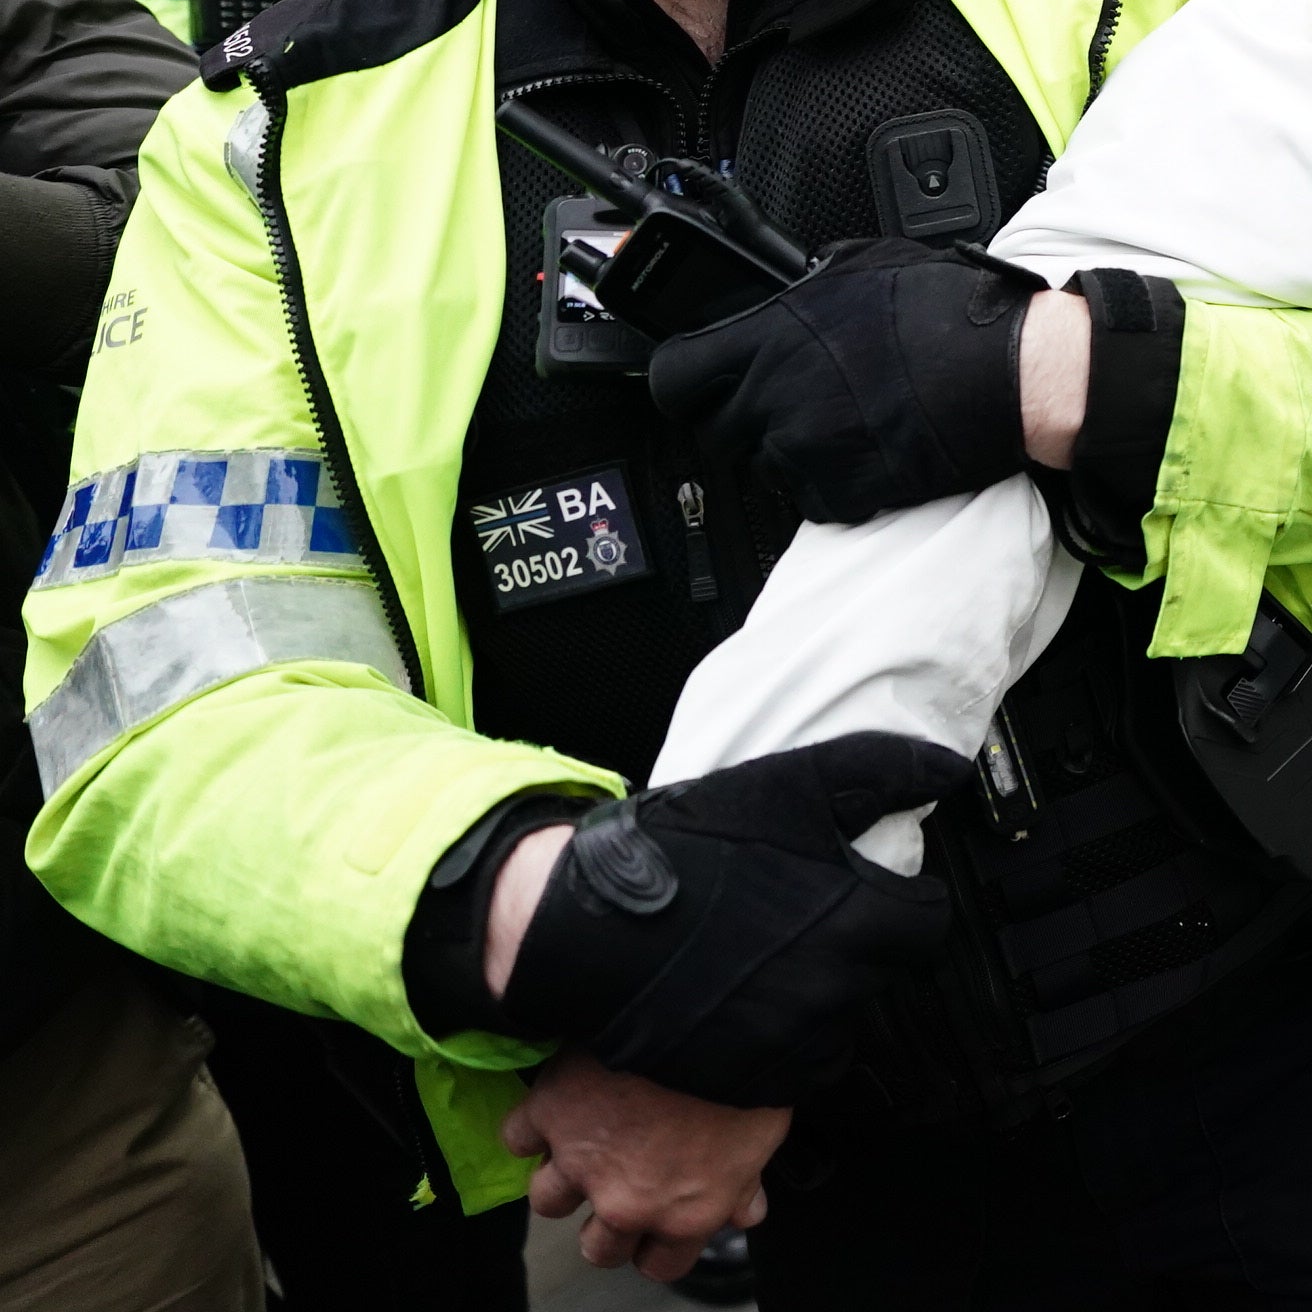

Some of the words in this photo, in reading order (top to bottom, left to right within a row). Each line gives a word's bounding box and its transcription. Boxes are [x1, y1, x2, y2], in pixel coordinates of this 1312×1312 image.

[101, 288, 137, 317] HIRE
[91, 306, 149, 357] ICE
[556, 481, 617, 523] BA
[494, 546, 584, 593] 30502
